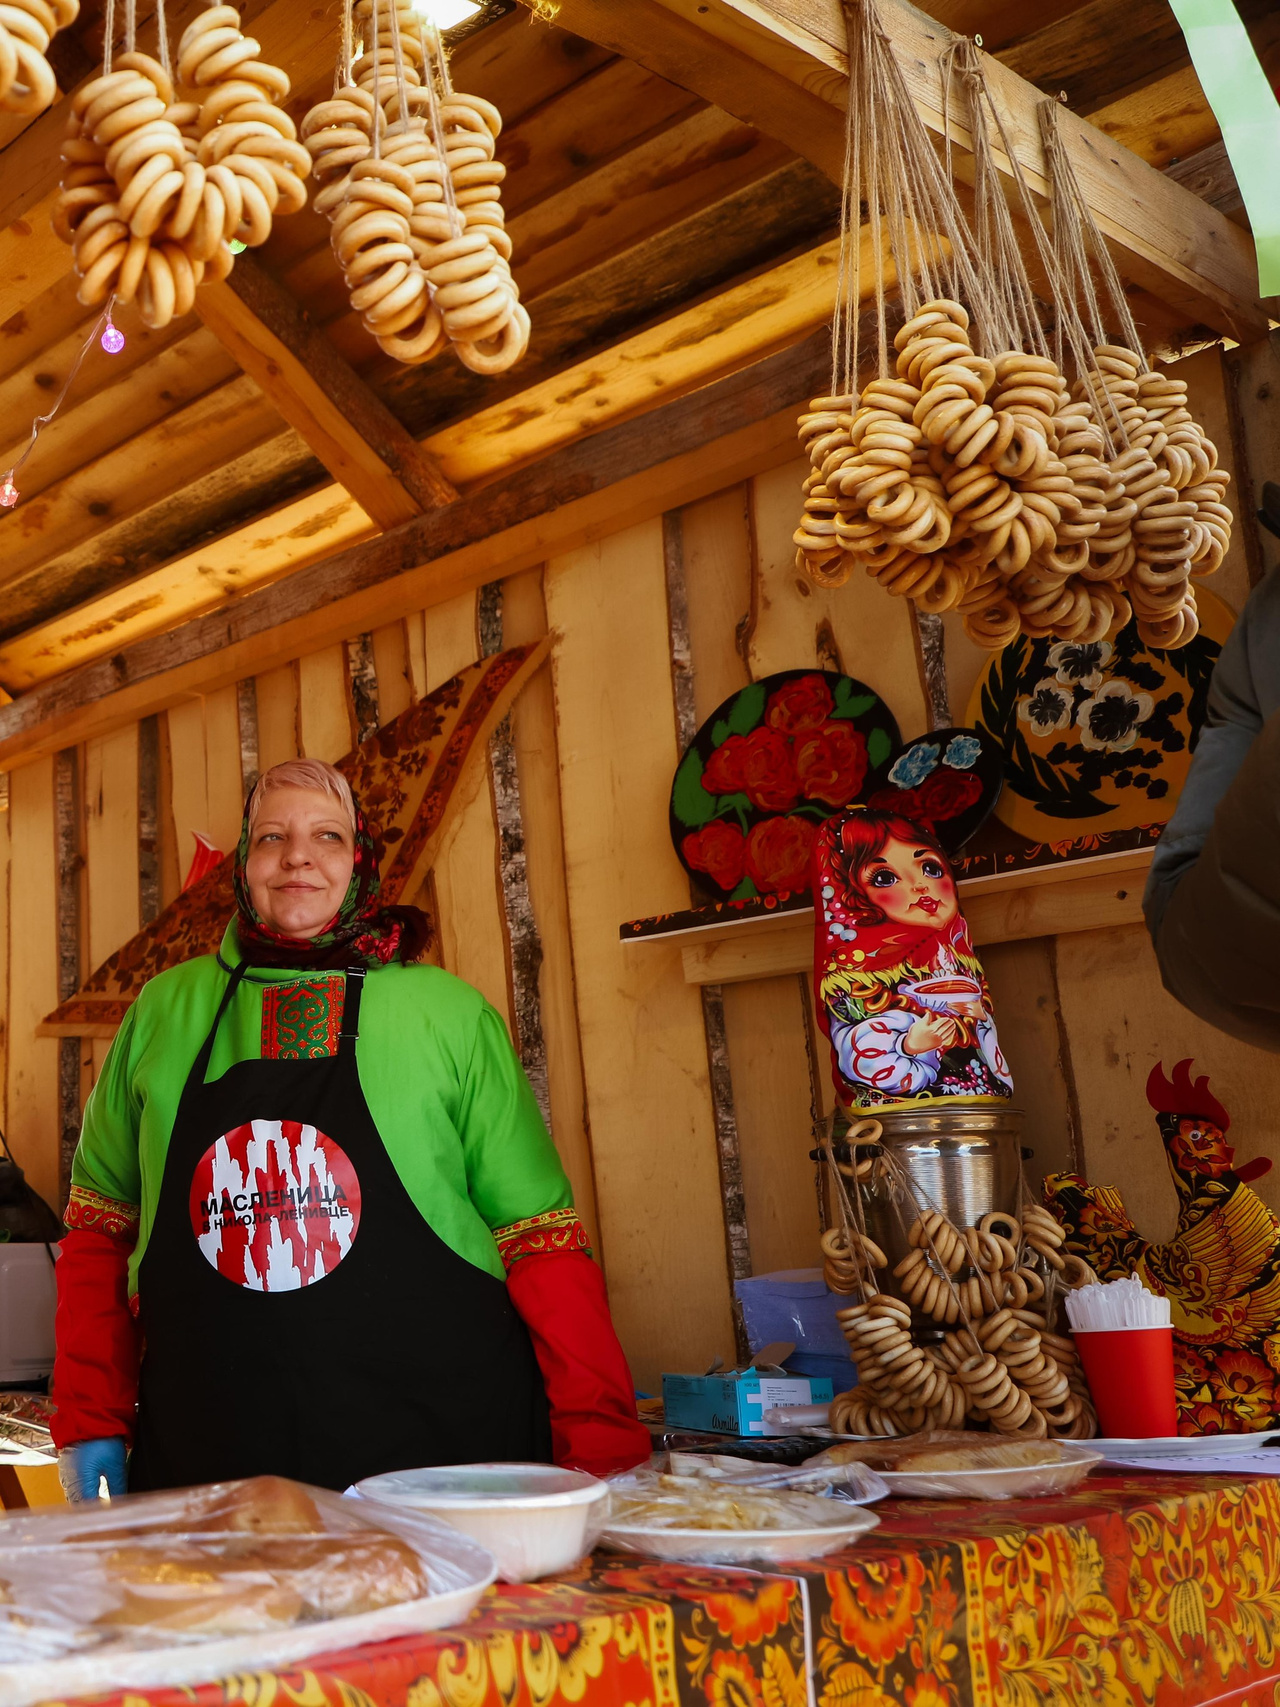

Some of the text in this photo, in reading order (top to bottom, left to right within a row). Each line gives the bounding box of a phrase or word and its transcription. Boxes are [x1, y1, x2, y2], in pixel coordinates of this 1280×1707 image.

[200, 1185, 346, 1218] МАСЛЕНИЦА
[202, 1206, 349, 1232] В НИКОЛА-ЛЕНИВЦЕ
